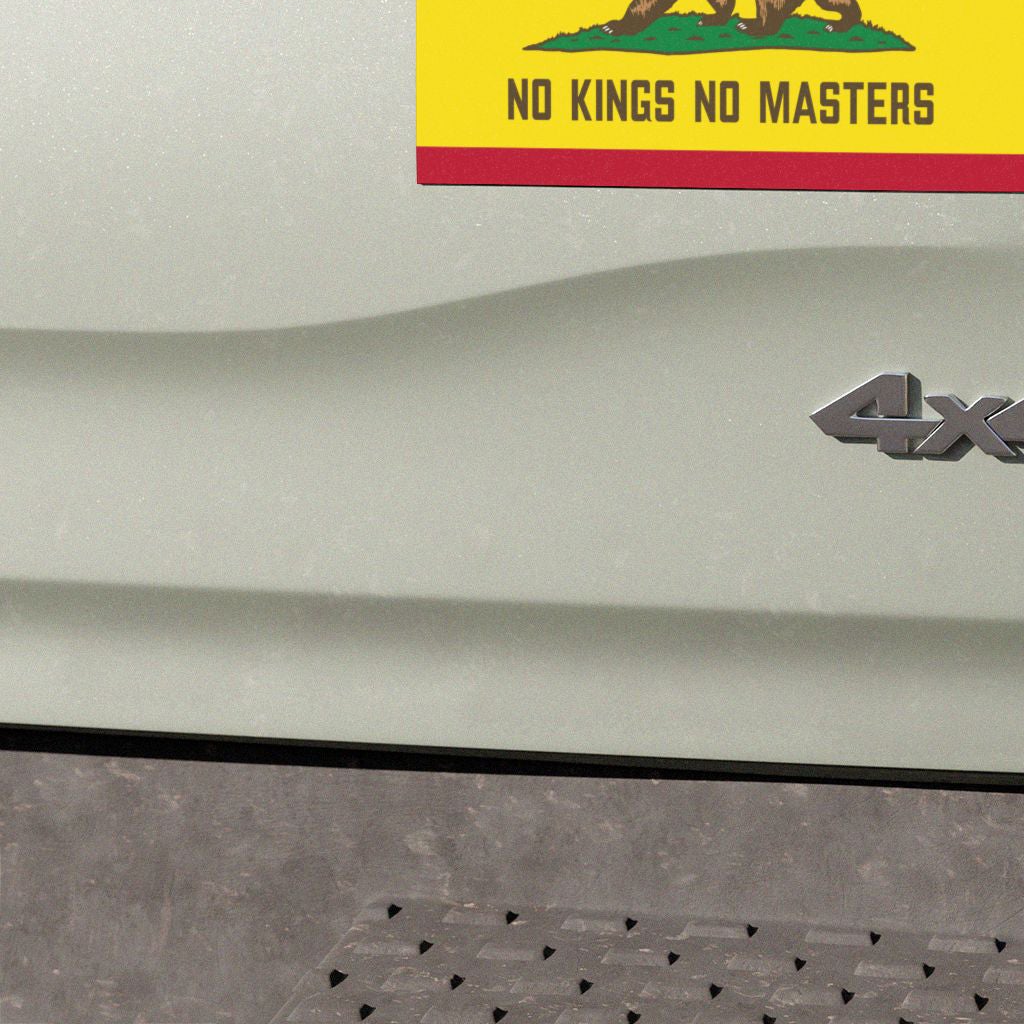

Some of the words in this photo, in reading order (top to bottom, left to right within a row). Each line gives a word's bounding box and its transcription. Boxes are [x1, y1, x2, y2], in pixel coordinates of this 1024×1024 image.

[508, 78, 551, 121] NO
[571, 79, 675, 123] KINGS
[695, 80, 740, 124] NO
[760, 81, 934, 125] MASTERS
